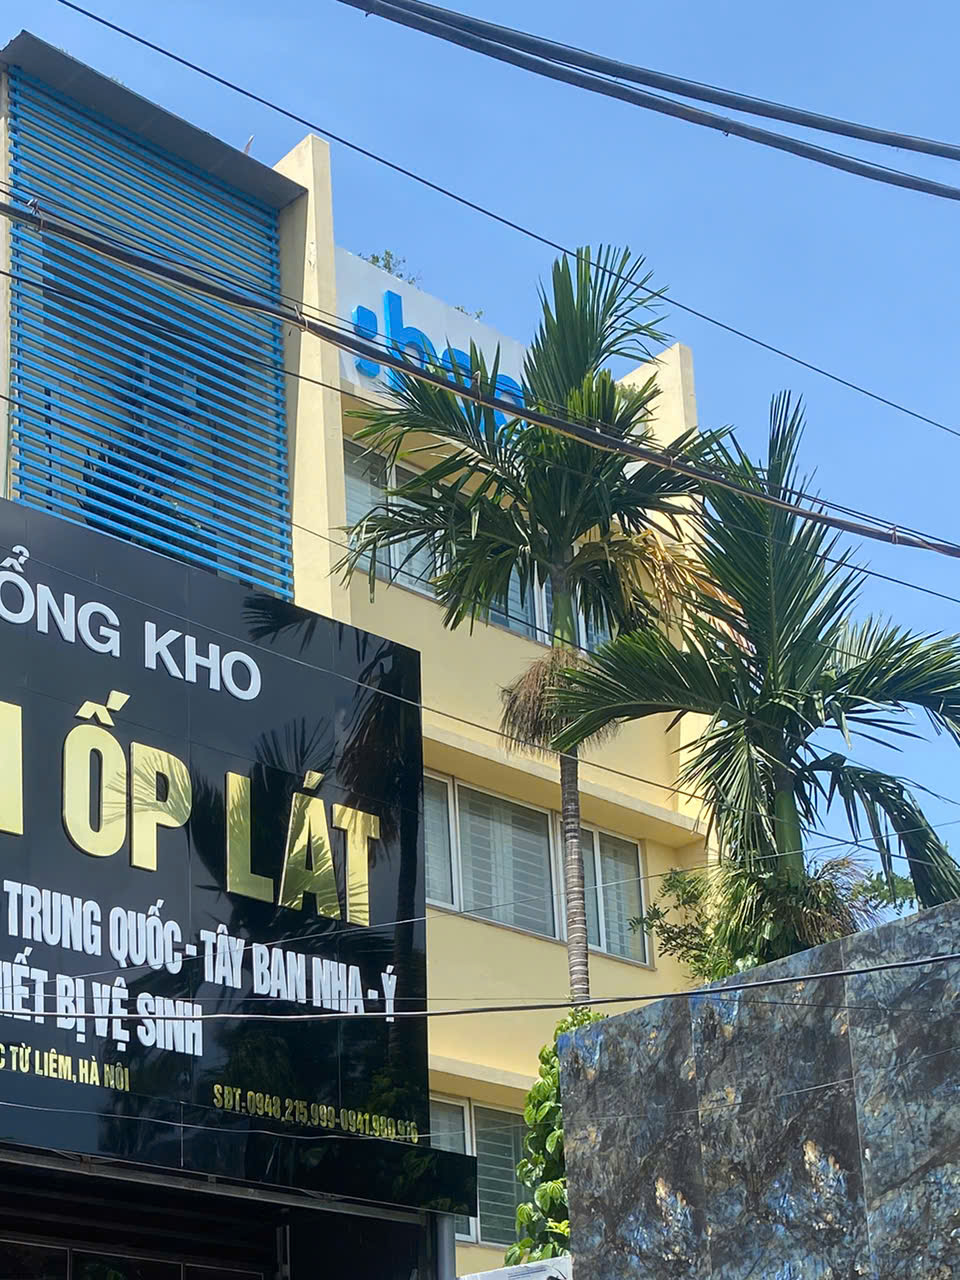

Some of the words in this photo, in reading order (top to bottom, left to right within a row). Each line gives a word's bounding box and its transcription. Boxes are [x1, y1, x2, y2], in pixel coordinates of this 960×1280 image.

[144, 620, 261, 701] KHO
[62, 689, 193, 872] ỐP
[225, 769, 381, 928] LÁT
[252, 942, 307, 1005] BAN
[55, 974, 86, 1043] BỊ
[91, 976, 130, 1052] VỆ
[136, 992, 203, 1057] SINH
[9, 1042, 32, 1073] TỪ
